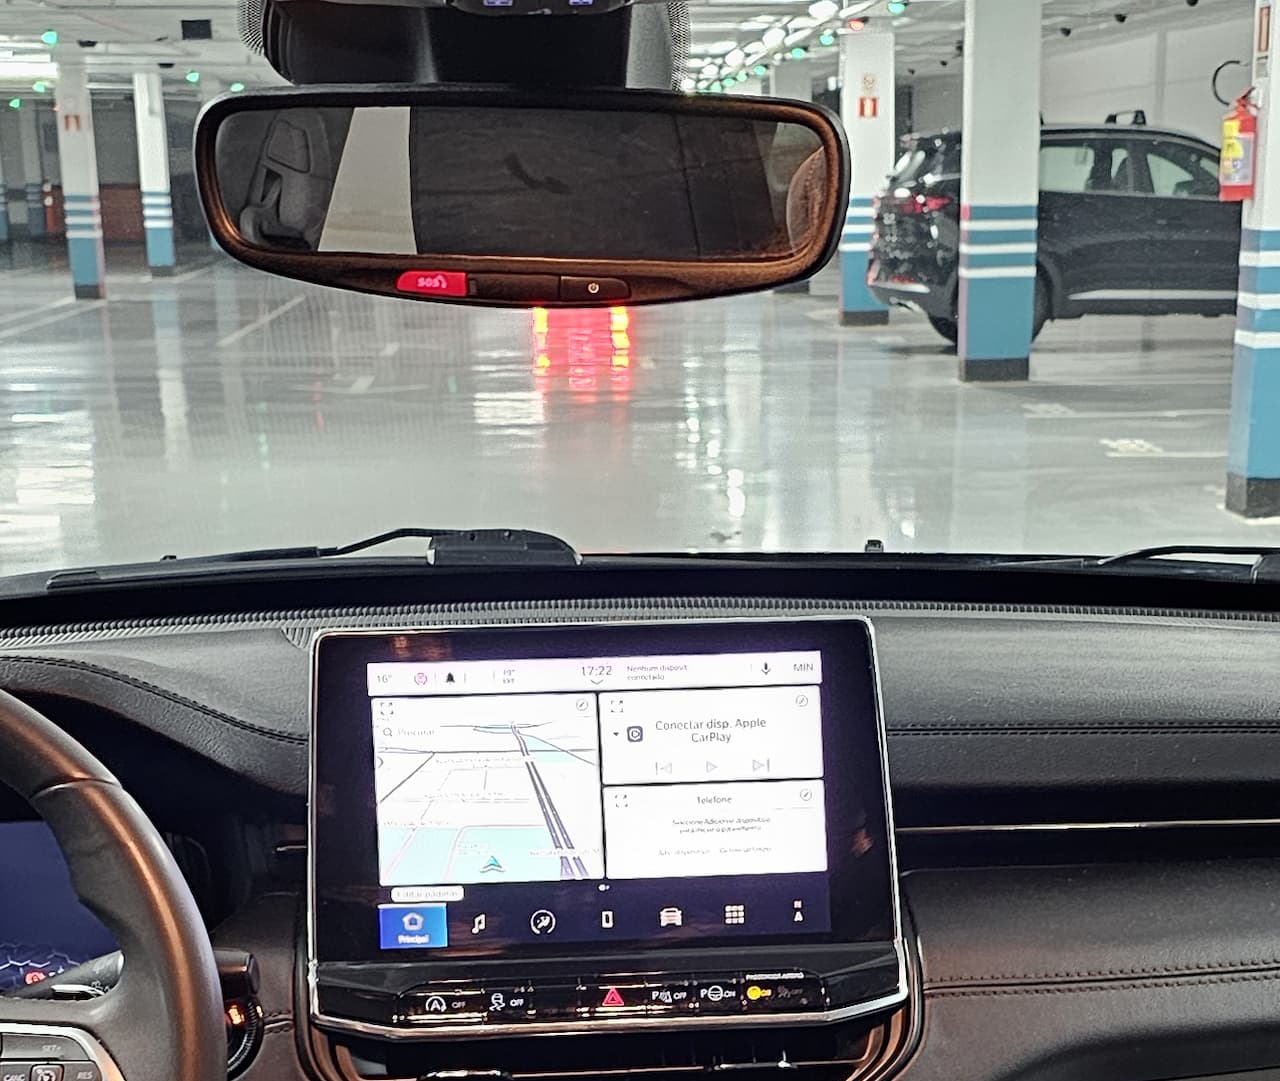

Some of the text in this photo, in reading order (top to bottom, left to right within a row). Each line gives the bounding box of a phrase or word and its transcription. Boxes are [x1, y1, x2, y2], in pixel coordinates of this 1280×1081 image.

[417, 277, 440, 288] SOS
[582, 665, 613, 677] 17:22
[793, 663, 814, 672] MIN
[655, 720, 703, 731] Conectar
[735, 718, 767, 729] Apple
[691, 732, 732, 743] CarPlay
[451, 1001, 466, 1009] OFF
